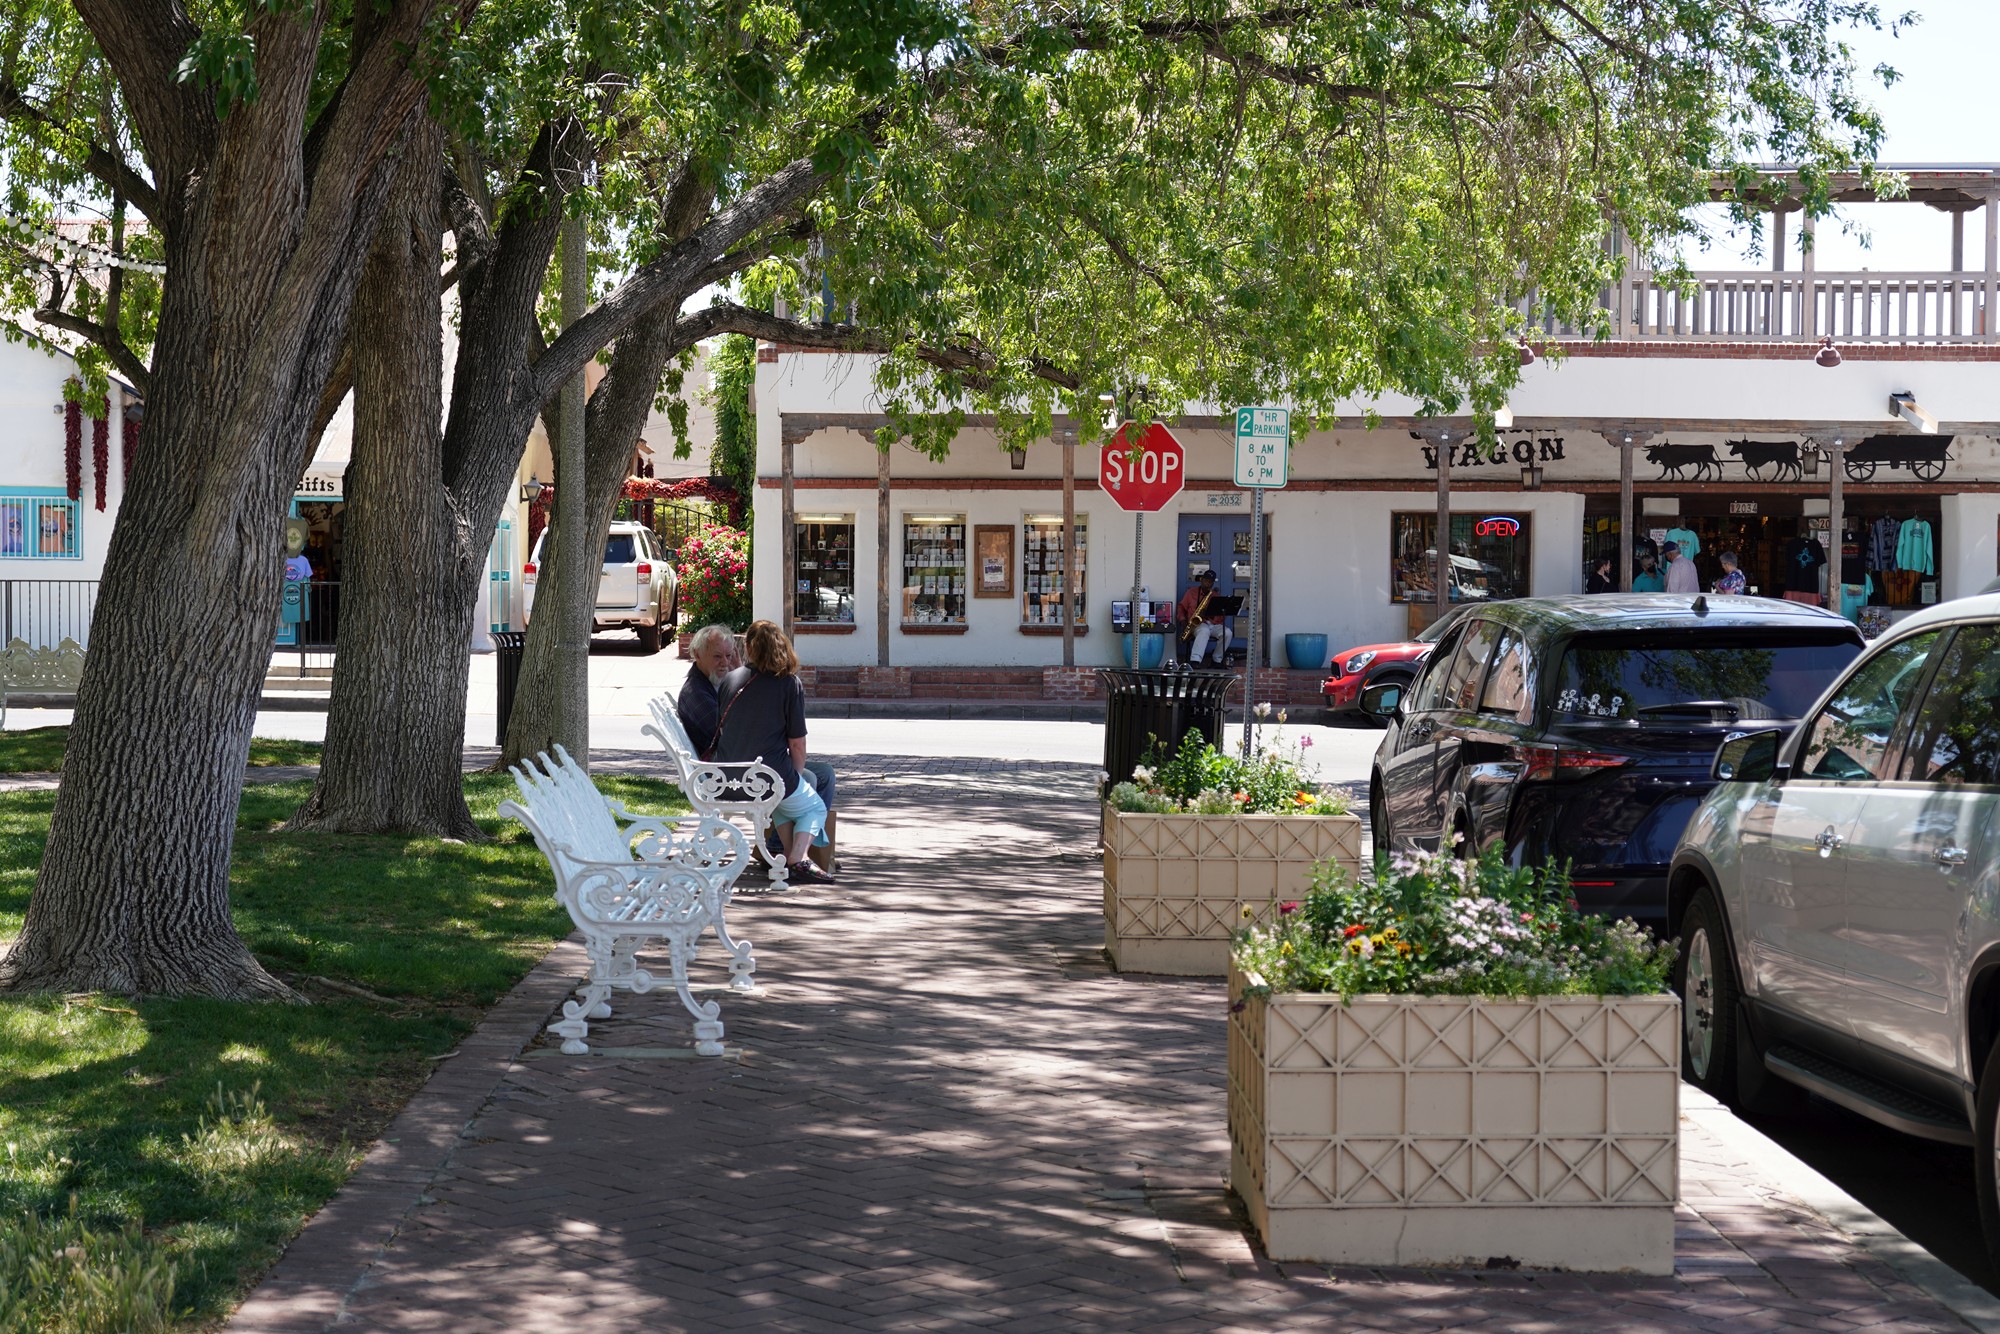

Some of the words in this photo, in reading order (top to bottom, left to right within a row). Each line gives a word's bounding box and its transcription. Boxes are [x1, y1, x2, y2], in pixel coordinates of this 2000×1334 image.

[1240, 413, 1251, 432] 2
[1264, 413, 1278, 422] HR
[1253, 424, 1286, 435] PARKING
[1248, 443, 1255, 454] 8
[1261, 444, 1274, 454] AM
[1421, 438, 1566, 469] WAGON
[1255, 455, 1267, 465] TO
[1106, 449, 1179, 484] STOP
[1248, 467, 1254, 477] 6
[1260, 468, 1273, 478] PM
[1219, 496, 1240, 505] 2032
[1475, 521, 1517, 537] OPEN
